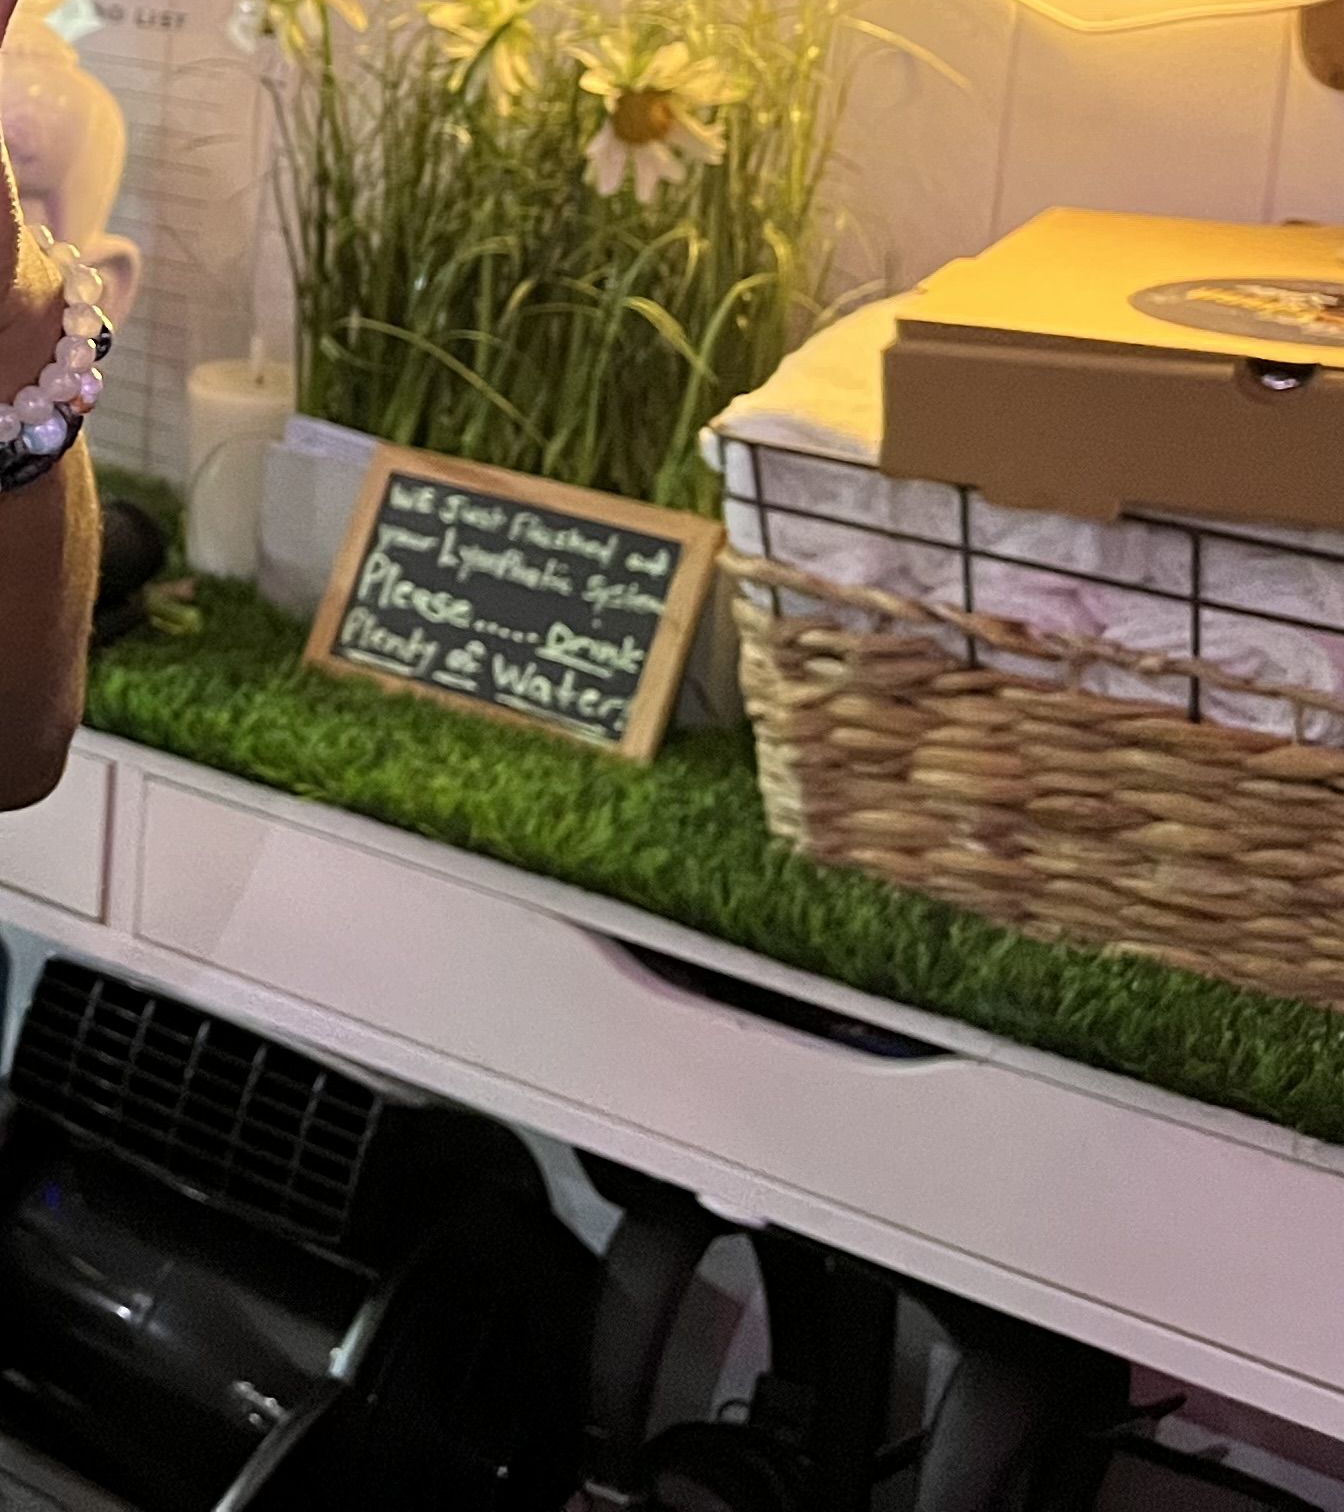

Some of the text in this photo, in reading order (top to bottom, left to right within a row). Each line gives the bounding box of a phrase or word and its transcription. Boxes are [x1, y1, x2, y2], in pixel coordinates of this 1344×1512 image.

[134, 5, 188, 31] LIST
[341, 606, 441, 675] Plenty
[544, 619, 645, 674] Drink
